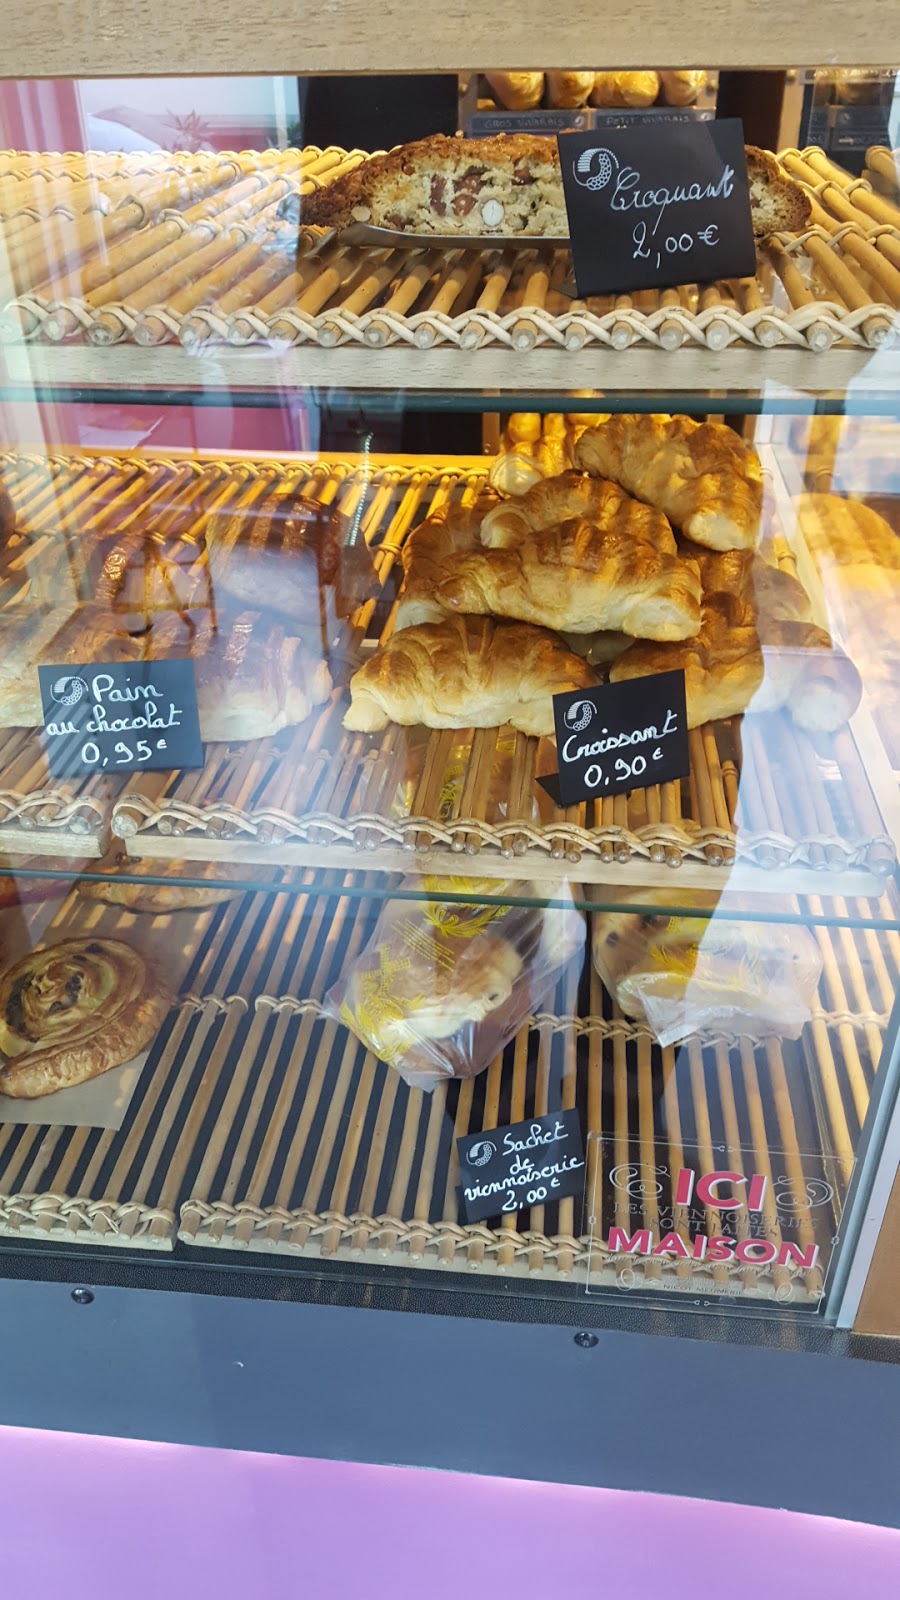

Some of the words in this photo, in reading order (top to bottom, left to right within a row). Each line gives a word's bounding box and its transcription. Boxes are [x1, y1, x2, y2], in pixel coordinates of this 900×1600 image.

[483, 119, 513, 129] GROS
[610, 164, 735, 236] Croquant
[632, 220, 721, 269] 2,00€
[91, 673, 164, 703] Pain
[46, 720, 80, 736] au
[86, 700, 183, 733] chocolat
[562, 709, 678, 763] Croissant
[502, 1121, 569, 1156] Sachet
[464, 1154, 585, 1201] viennoiserie
[509, 1154, 535, 1175] de
[613, 1201, 647, 1215] LES
[675, 1168, 768, 1212] ICI
[649, 1217, 706, 1232] SONT
[710, 1221, 778, 1238] FAITES
[607, 1227, 820, 1269] MAISON
